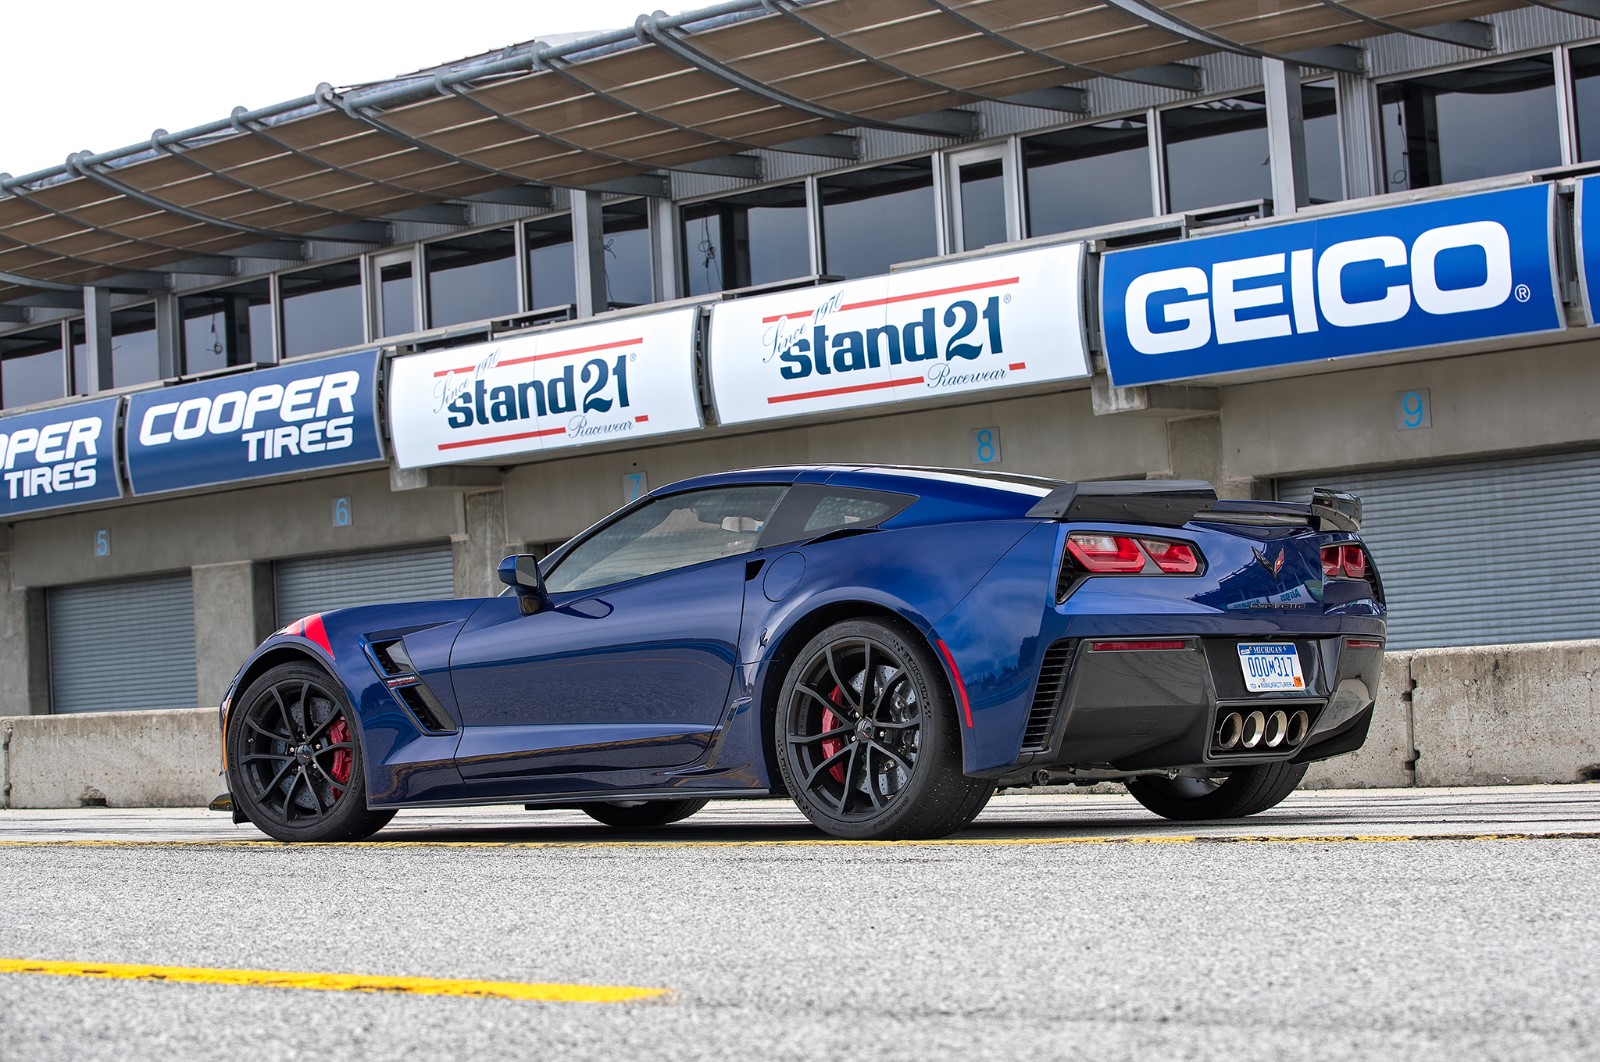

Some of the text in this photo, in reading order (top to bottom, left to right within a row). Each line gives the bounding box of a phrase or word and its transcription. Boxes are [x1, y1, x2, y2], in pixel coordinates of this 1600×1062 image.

[1124, 220, 1512, 355] GEICO
[762, 289, 844, 363] Since 1970
[433, 373, 469, 414] Since
[927, 362, 1007, 389] Racewear
[139, 370, 360, 446] COOPER
[568, 415, 633, 438] Racewear
[1402, 391, 1424, 429] 9
[0, 417, 102, 470] PER
[242, 416, 354, 462] TIRES
[977, 429, 995, 463] 8
[4, 458, 97, 499] TIRES
[626, 474, 641, 501] 7
[335, 498, 348, 526] 6
[96, 530, 108, 557] 5
[1253, 646, 1283, 654] MICHIGAN
